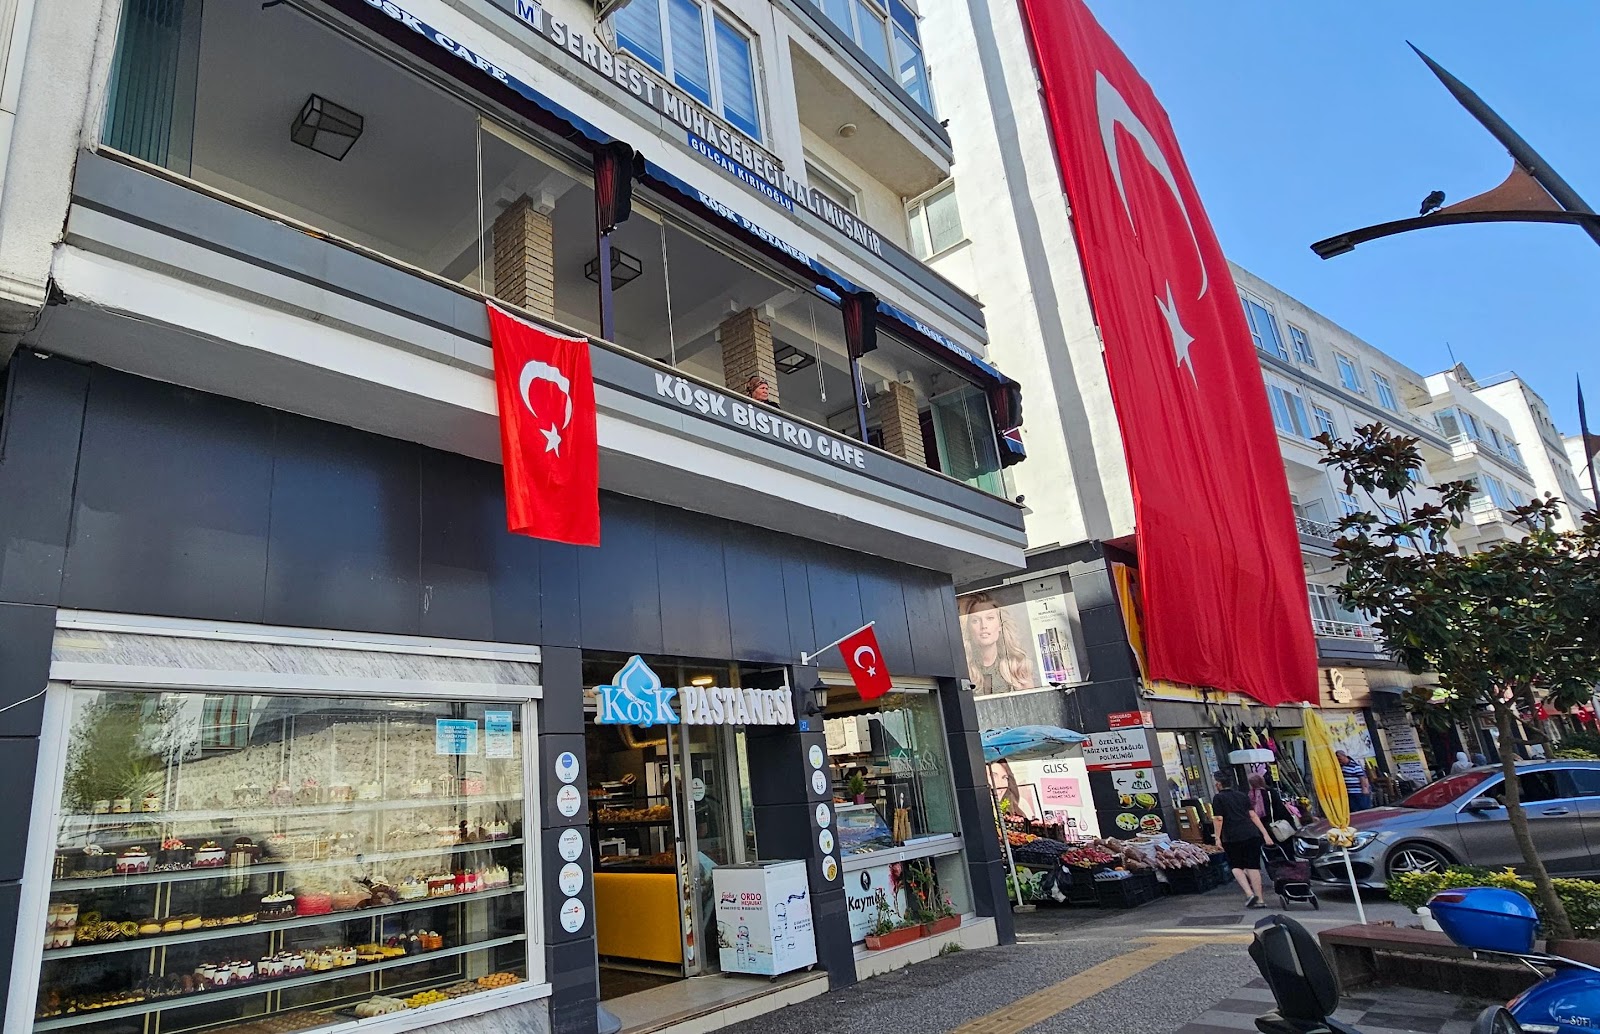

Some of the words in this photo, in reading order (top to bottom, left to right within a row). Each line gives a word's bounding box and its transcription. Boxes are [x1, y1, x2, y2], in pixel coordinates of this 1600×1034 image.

[434, 33, 509, 84] CAFE
[550, 16, 656, 105] SERBEST
[662, 87, 780, 188] MUHASEBECİ
[782, 170, 821, 216] MALİ
[822, 198, 883, 257] MÜŞAVİR
[691, 138, 735, 174] GÜLCAN
[737, 168, 791, 210] KIRIKOĞLU
[654, 372, 728, 417] KÖŞK
[731, 402, 813, 450] BİSTRO
[816, 436, 866, 470] CAFE
[681, 686, 796, 726] PASTANESİ
[1098, 738, 1114, 746] ÖZEL
[1120, 743, 1144, 751] SAĞLIĞI
[1042, 763, 1069, 774] GLISS
[1099, 752, 1134, 761] POLİKLİNİĞİ
[740, 892, 762, 901] ORDO
